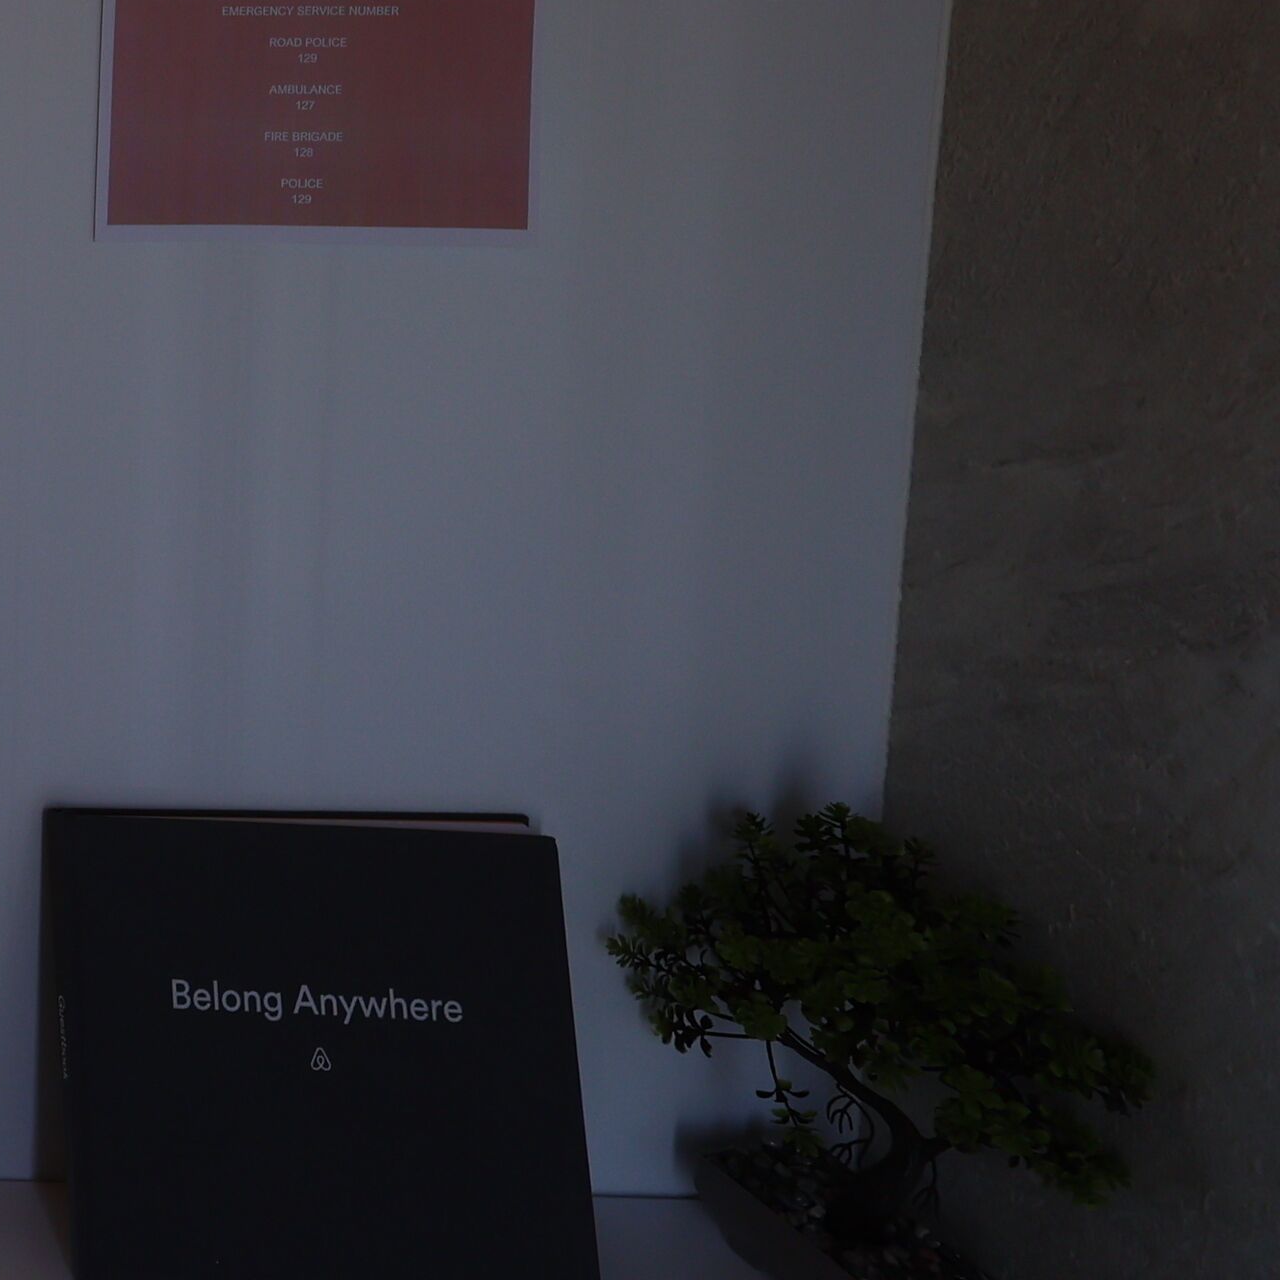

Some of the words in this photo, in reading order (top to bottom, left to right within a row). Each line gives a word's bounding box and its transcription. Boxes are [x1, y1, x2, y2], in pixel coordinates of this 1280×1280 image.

[221, 6, 294, 17] EMERGENCY
[296, 6, 346, 17] SERVICE
[348, 6, 400, 17] NUMBER
[269, 37, 302, 48] ROAD
[305, 37, 348, 48] POLICE
[297, 53, 318, 63] 129
[268, 84, 343, 95] AMBULANCE
[295, 100, 316, 111] 127
[264, 131, 289, 142] FIRE
[292, 131, 344, 142] BRIGADE
[295, 147, 314, 158] 128
[280, 178, 324, 189] POLICE
[291, 194, 312, 204] 129
[170, 978, 284, 1021] Belong
[292, 984, 464, 1024] Anywhere
